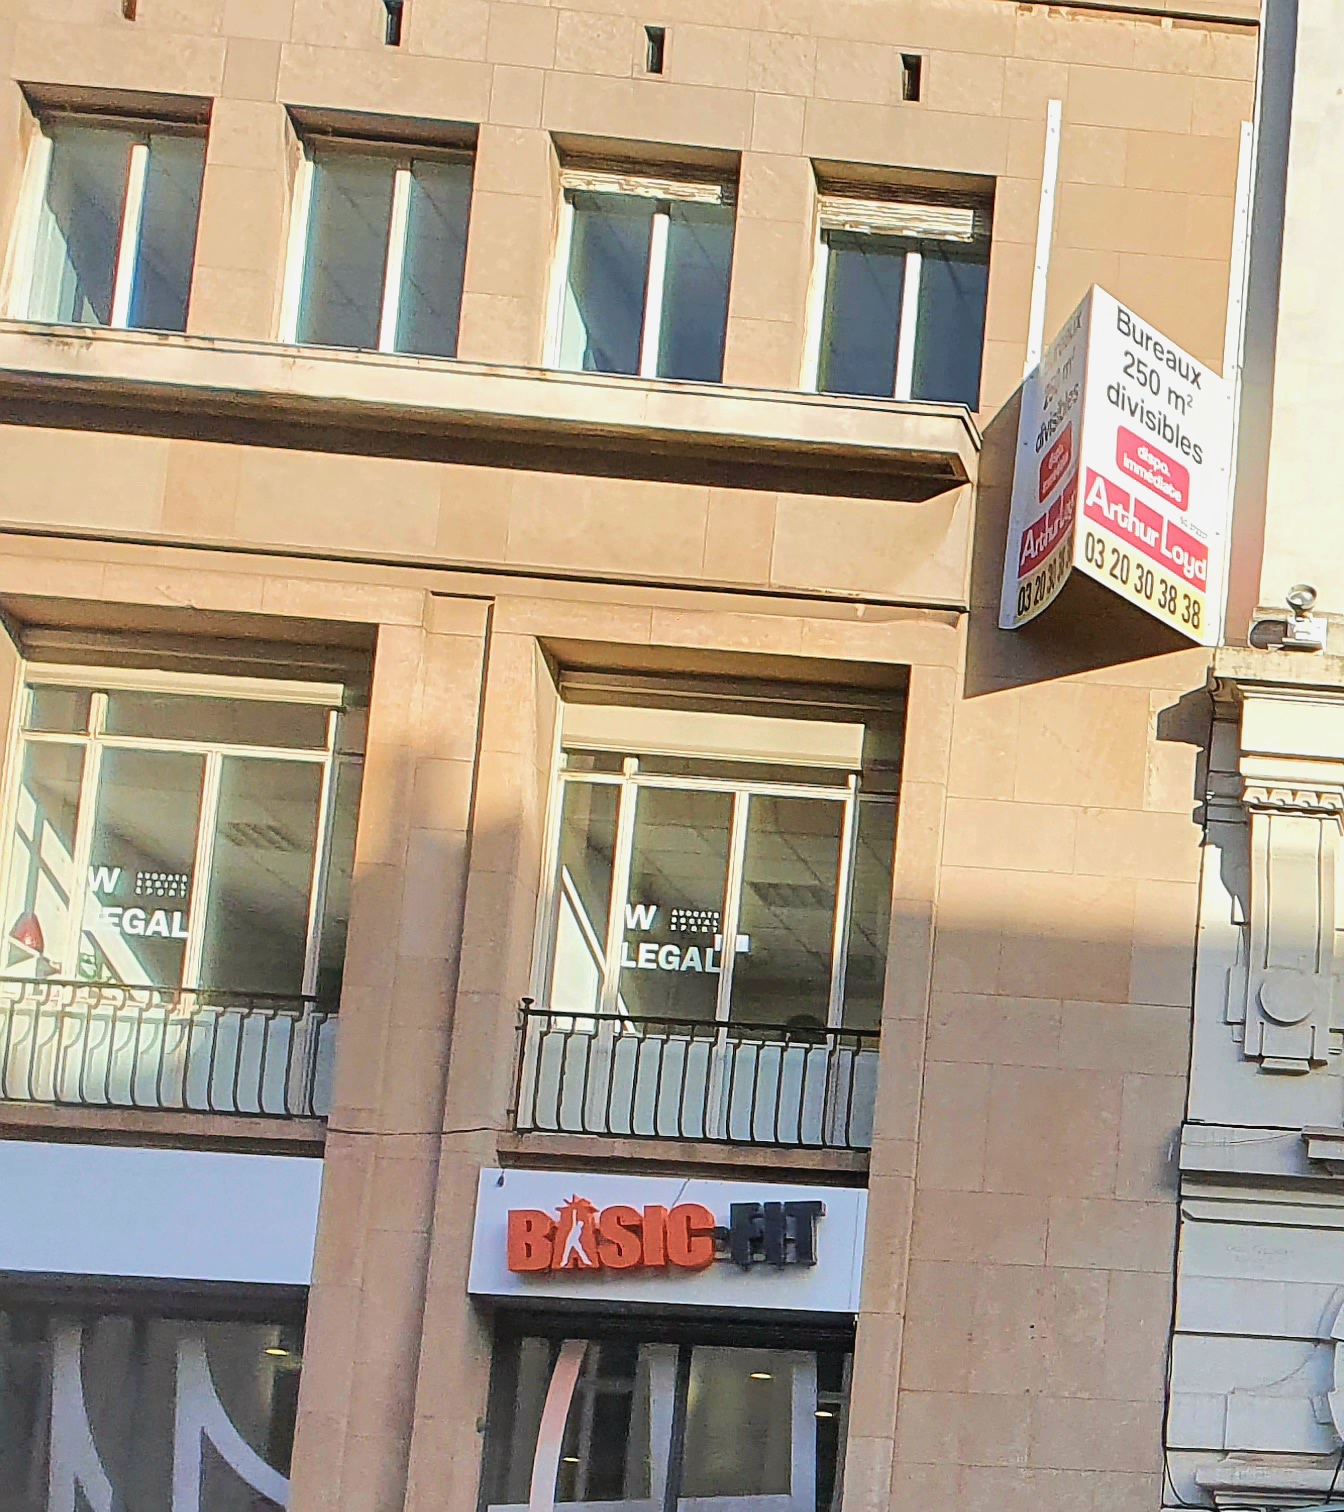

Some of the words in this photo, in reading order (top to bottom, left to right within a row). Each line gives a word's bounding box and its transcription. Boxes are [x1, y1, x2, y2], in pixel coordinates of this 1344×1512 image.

[1116, 305, 1202, 390] Bureaux
[1123, 350, 1161, 397] 250
[1167, 386, 1194, 416] m²
[1107, 381, 1203, 465] divisibles
[1019, 510, 1060, 567] Arthur
[1085, 475, 1160, 548] Arthur
[1160, 513, 1207, 581] Loyd
[1017, 581, 1033, 617] 03
[1033, 570, 1046, 606] 20
[1085, 531, 1105, 570] 03
[1109, 547, 1131, 585] 20
[1134, 562, 1155, 601] 30
[1158, 577, 1178, 616] 38
[1181, 593, 1201, 630] 38
[88, 865, 121, 894] W
[625, 903, 658, 930] W
[620, 941, 722, 973] LEGAL
